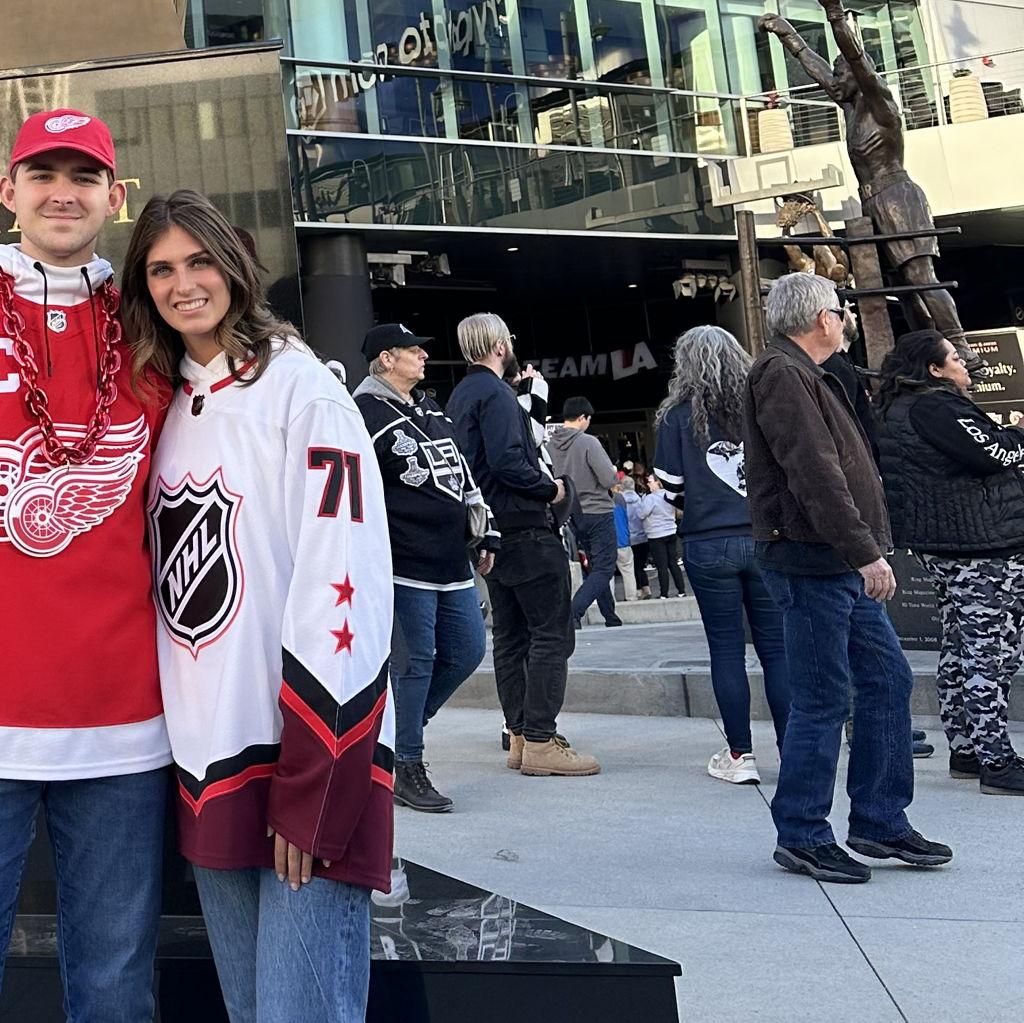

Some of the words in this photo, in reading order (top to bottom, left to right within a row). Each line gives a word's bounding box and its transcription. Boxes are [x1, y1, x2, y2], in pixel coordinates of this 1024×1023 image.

[610, 341, 658, 381] LA
[980, 363, 1017, 377] oyalty.
[956, 418, 990, 444] Los
[308, 447, 364, 524] 71
[167, 518, 217, 613] NHL
